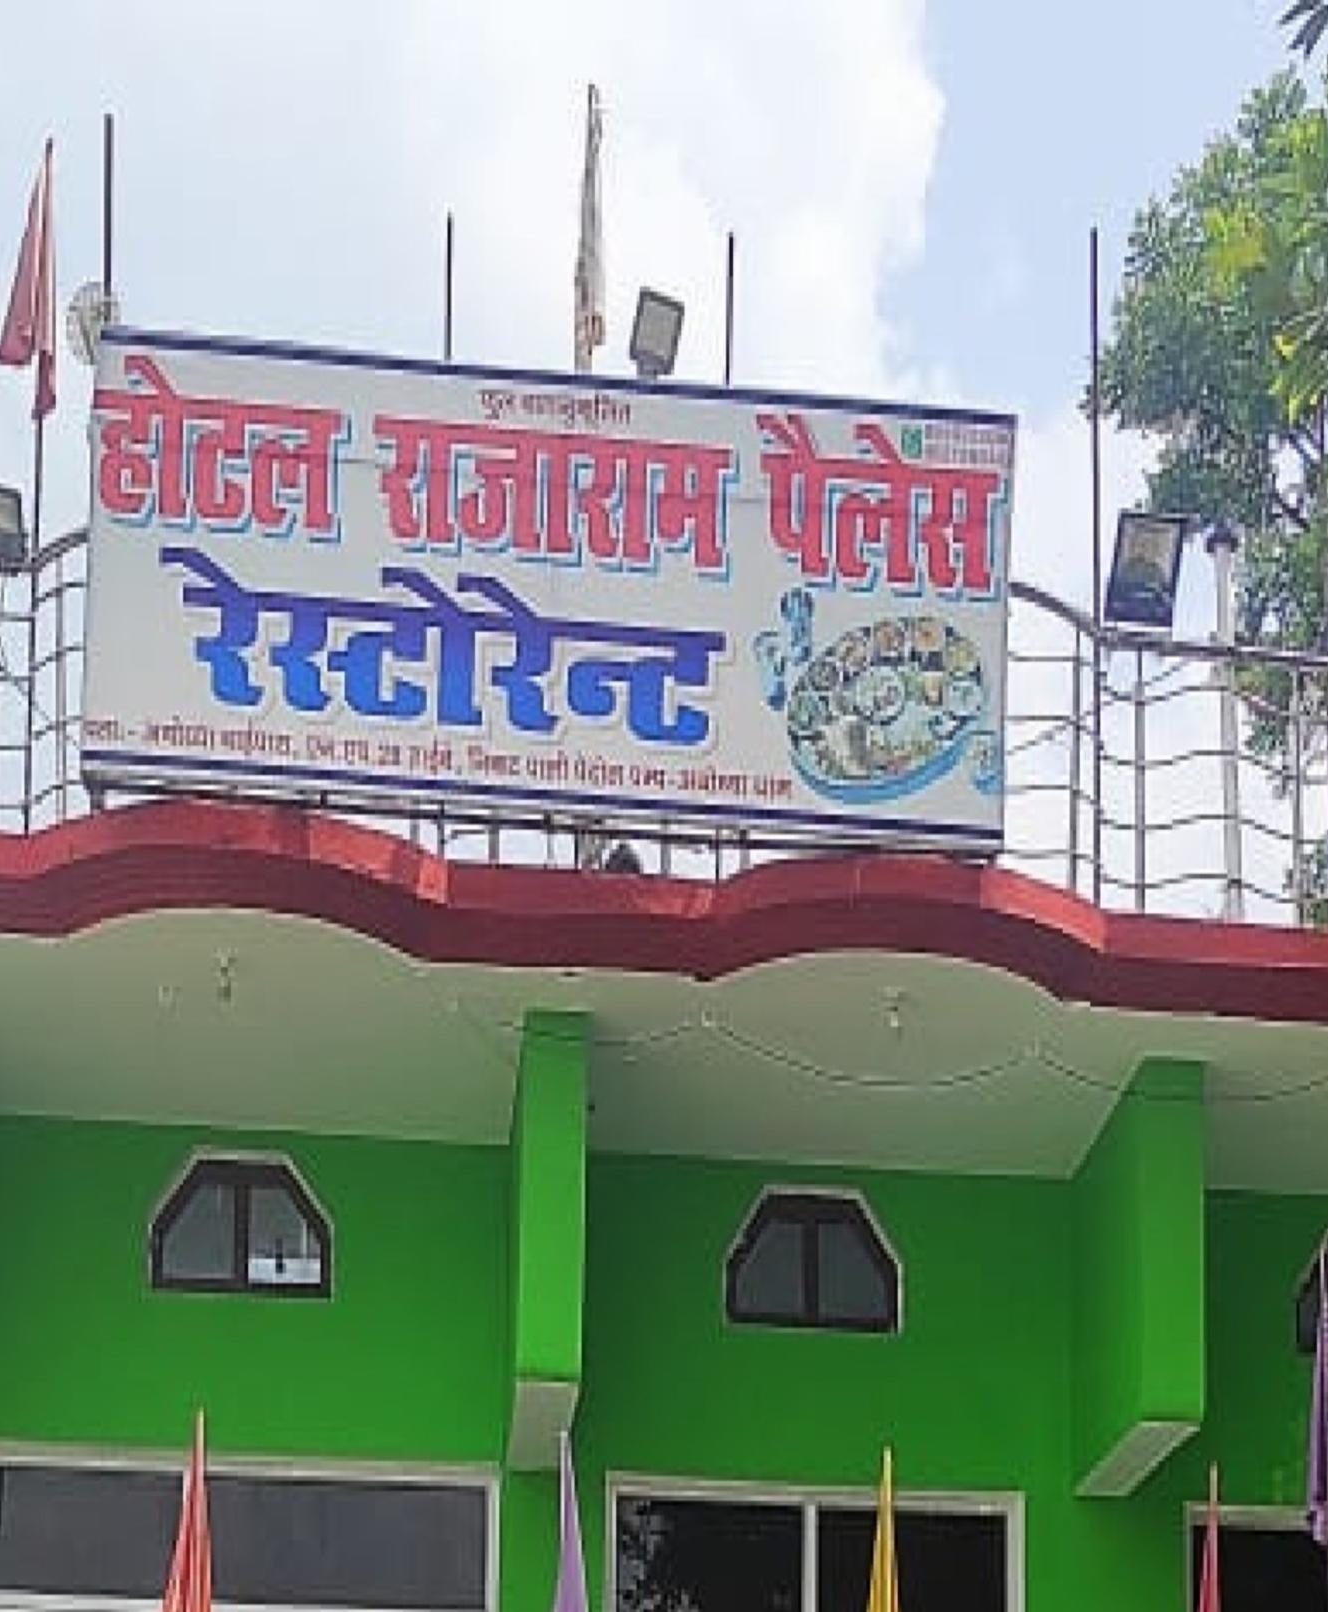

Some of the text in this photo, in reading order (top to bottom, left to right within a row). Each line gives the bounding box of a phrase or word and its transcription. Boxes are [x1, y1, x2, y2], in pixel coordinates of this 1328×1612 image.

[95, 355, 1004, 596] होटल राजाराम पैलेस
[161, 546, 726, 746] रेस्टोरेन्ट
